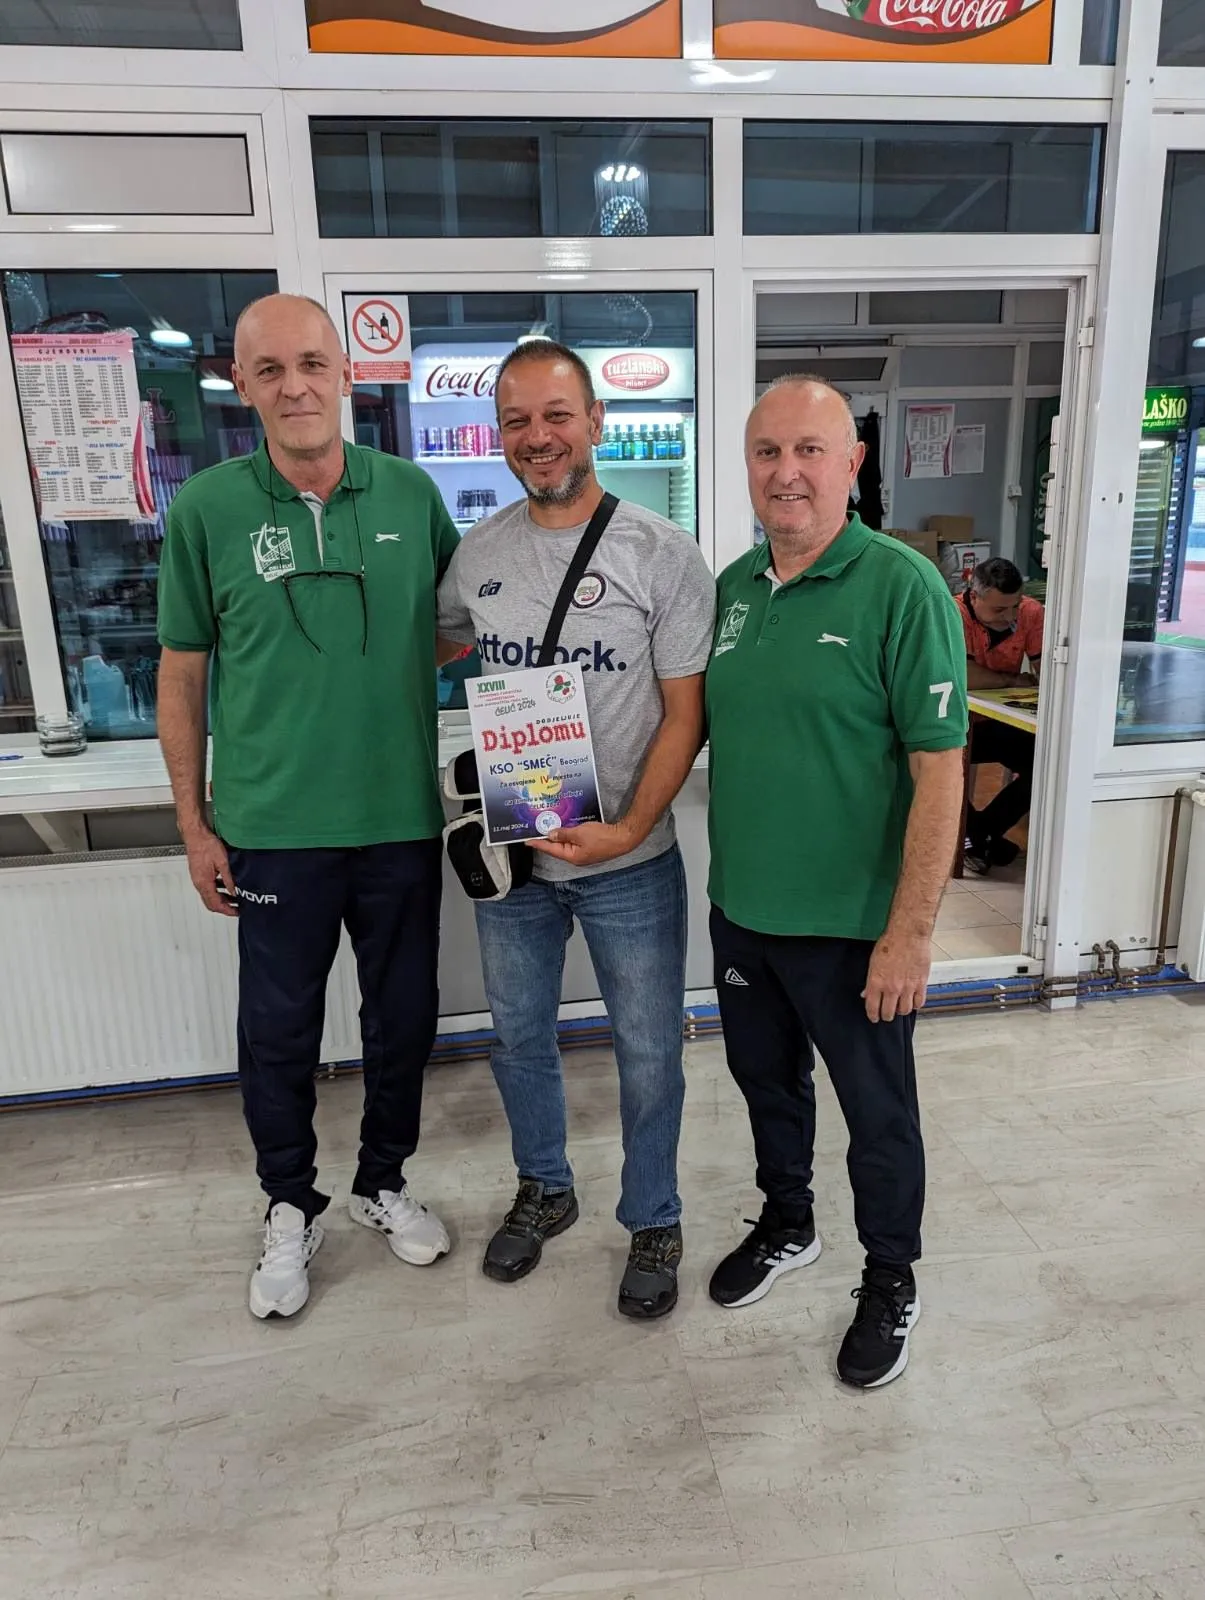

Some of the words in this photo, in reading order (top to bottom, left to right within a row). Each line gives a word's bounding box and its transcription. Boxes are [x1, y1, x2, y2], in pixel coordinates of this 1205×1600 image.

[1142, 393, 1188, 420] LAŠKO
[477, 679, 506, 693] XXVIII
[518, 699, 536, 711] 2024
[929, 681, 954, 718] 7
[481, 721, 587, 755] Diplomu
[489, 762, 514, 776] KSO
[560, 755, 589, 766] Beograd
[540, 775, 549, 784] IV
